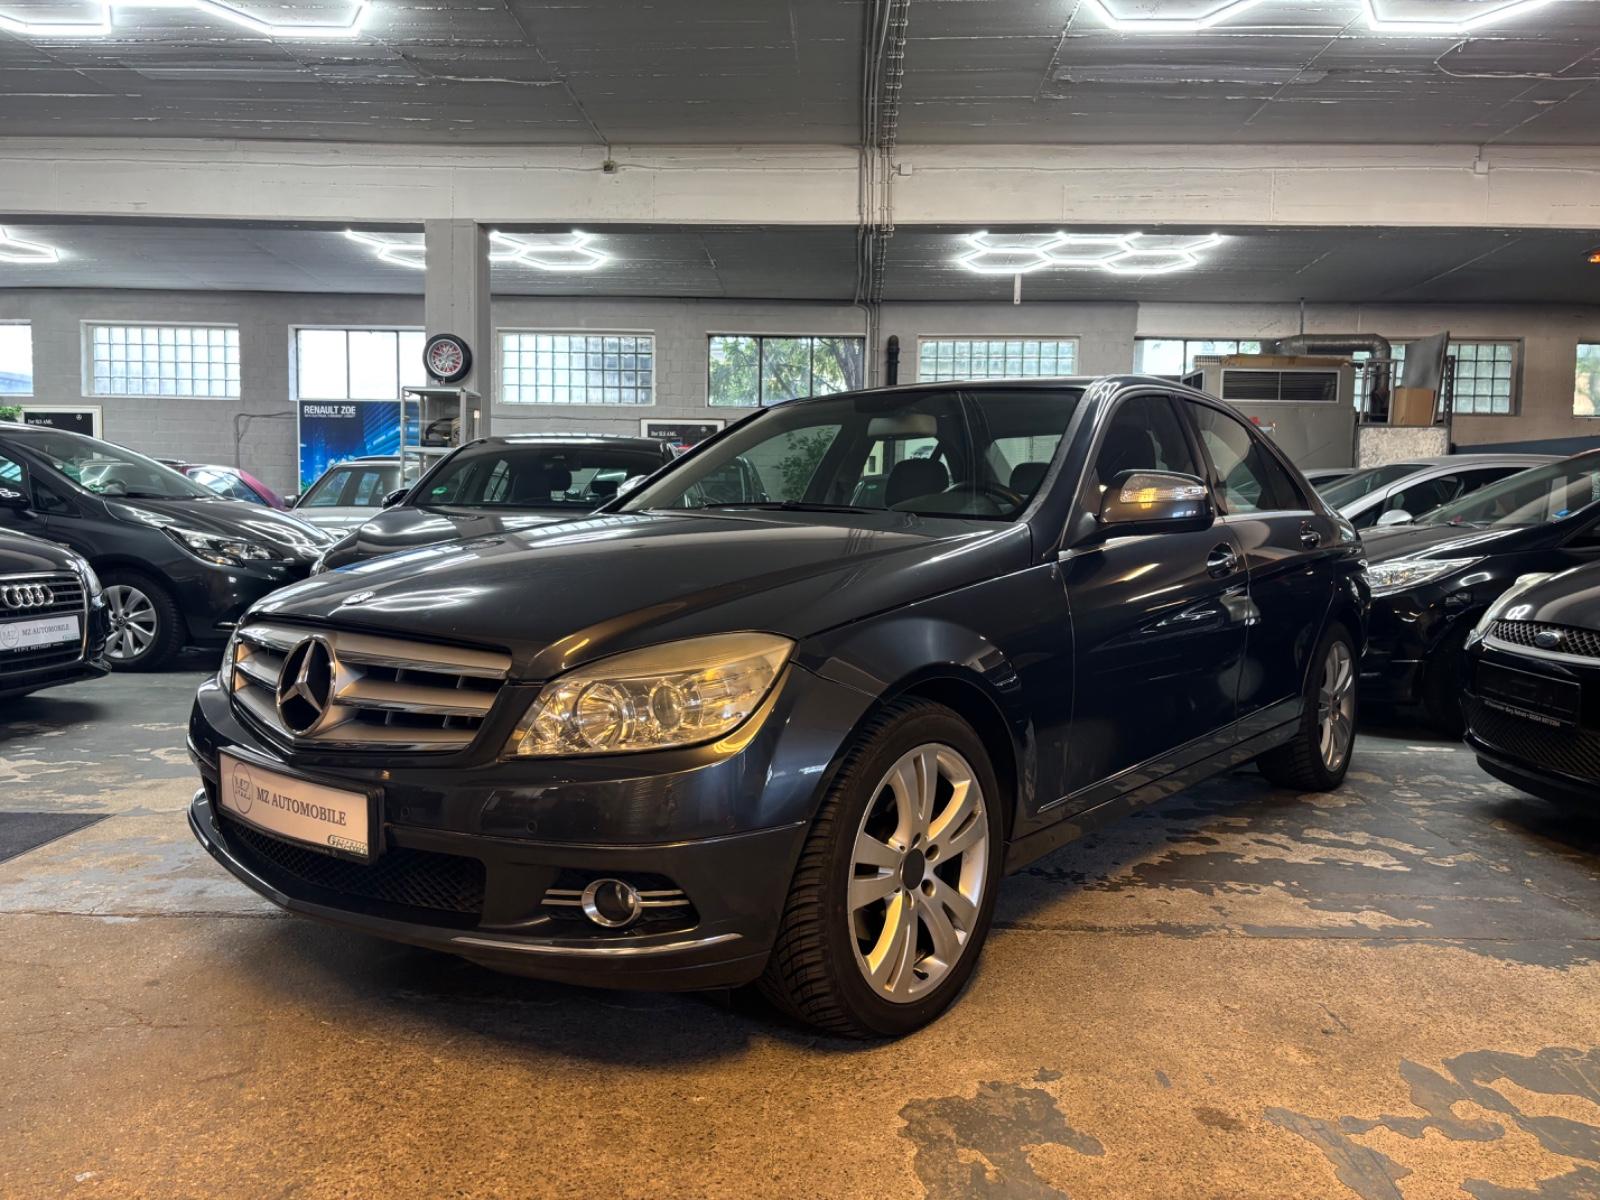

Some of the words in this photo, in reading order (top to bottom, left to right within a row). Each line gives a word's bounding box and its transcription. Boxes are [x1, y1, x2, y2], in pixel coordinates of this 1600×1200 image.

[304, 405, 339, 414] RENAULT
[341, 405, 356, 414] ZOE
[22, 628, 30, 636] MZ
[33, 623, 69, 634] AUTOMOBILE
[256, 787, 270, 804] MZ
[272, 793, 347, 826] AUTOMOBILE
